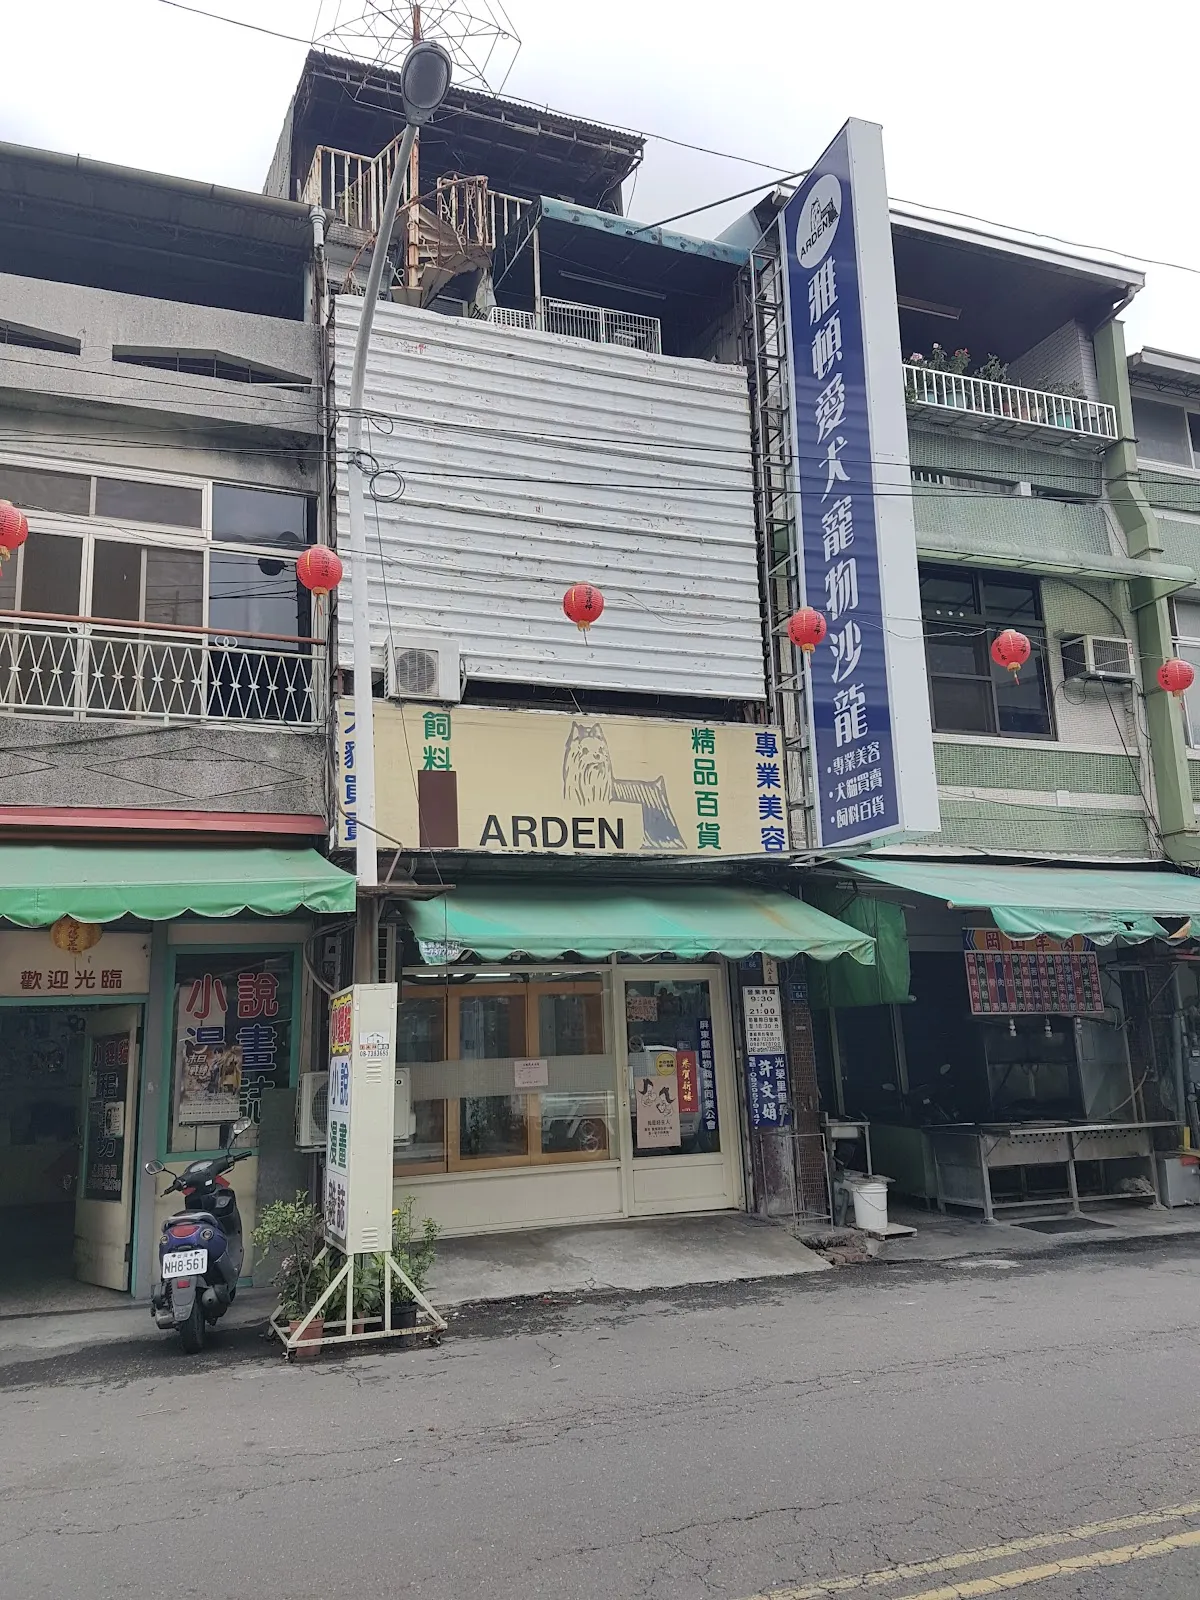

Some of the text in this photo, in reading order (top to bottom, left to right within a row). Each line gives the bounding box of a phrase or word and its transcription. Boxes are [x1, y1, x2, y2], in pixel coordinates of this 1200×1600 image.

[800, 216, 830, 259] ARDEN
[807, 256, 869, 748] 雅頓愛犬寵物沙龍
[422, 711, 453, 771] 飼料
[833, 741, 881, 775] 專業美容
[691, 727, 722, 851] 精品百貨
[755, 731, 786, 852] 專業美容
[479, 814, 625, 850] ARDEN
[836, 795, 885, 829] 飼料百貨
[20, 969, 123, 990] 歡迎光臨
[185, 972, 279, 1019] 小說
[164, 1257, 204, 1274] NH8-561
